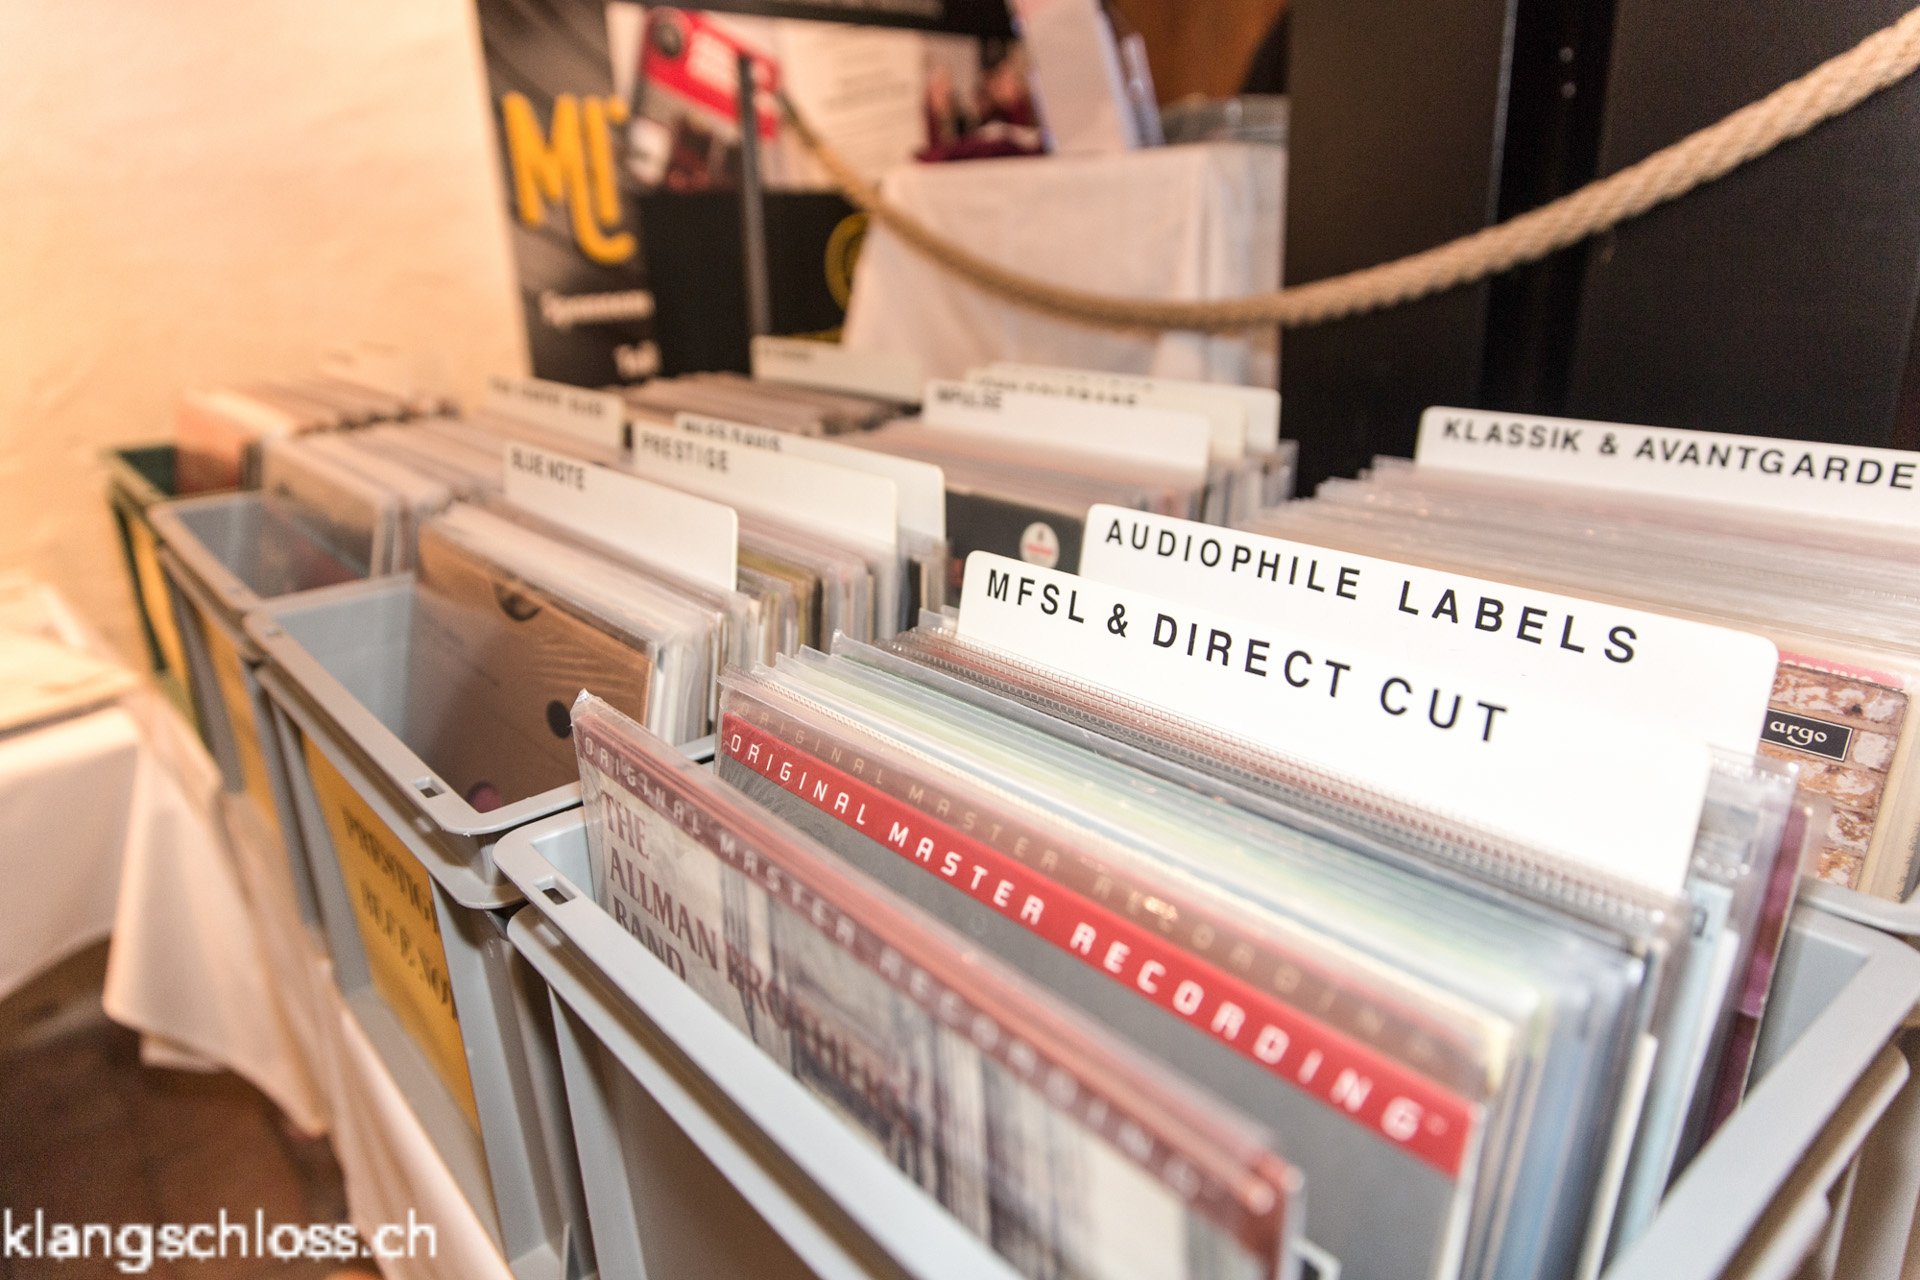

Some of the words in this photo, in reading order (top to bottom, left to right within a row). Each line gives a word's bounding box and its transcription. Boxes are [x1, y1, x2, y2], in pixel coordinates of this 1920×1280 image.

[510, 447, 545, 480] BLUE
[549, 457, 585, 491] NOTE
[640, 431, 730, 474] PRESTIGE
[1443, 417, 1583, 453] KLASSIK
[1599, 432, 1617, 456] &
[1635, 437, 1918, 490] AVANTGARDE
[1105, 518, 1360, 601] AUDIOPHILE
[1398, 580, 1638, 664] LABELS
[986, 569, 1087, 624] MFSL
[1107, 603, 1129, 638] &
[1152, 614, 1350, 698] DIRECT
[1380, 677, 1508, 743] CUT
[1769, 719, 1828, 746] argo
[584, 736, 703, 836] ORIGINAL
[719, 832, 857, 943] MASTER
[601, 788, 650, 861] THE
[908, 784, 1059, 867] MASTER
[610, 845, 719, 972] ALLMAN
[730, 733, 866, 826] ORIGINAL
[888, 820, 1046, 926] MASTER
[1068, 920, 1425, 1143] RECORDING
